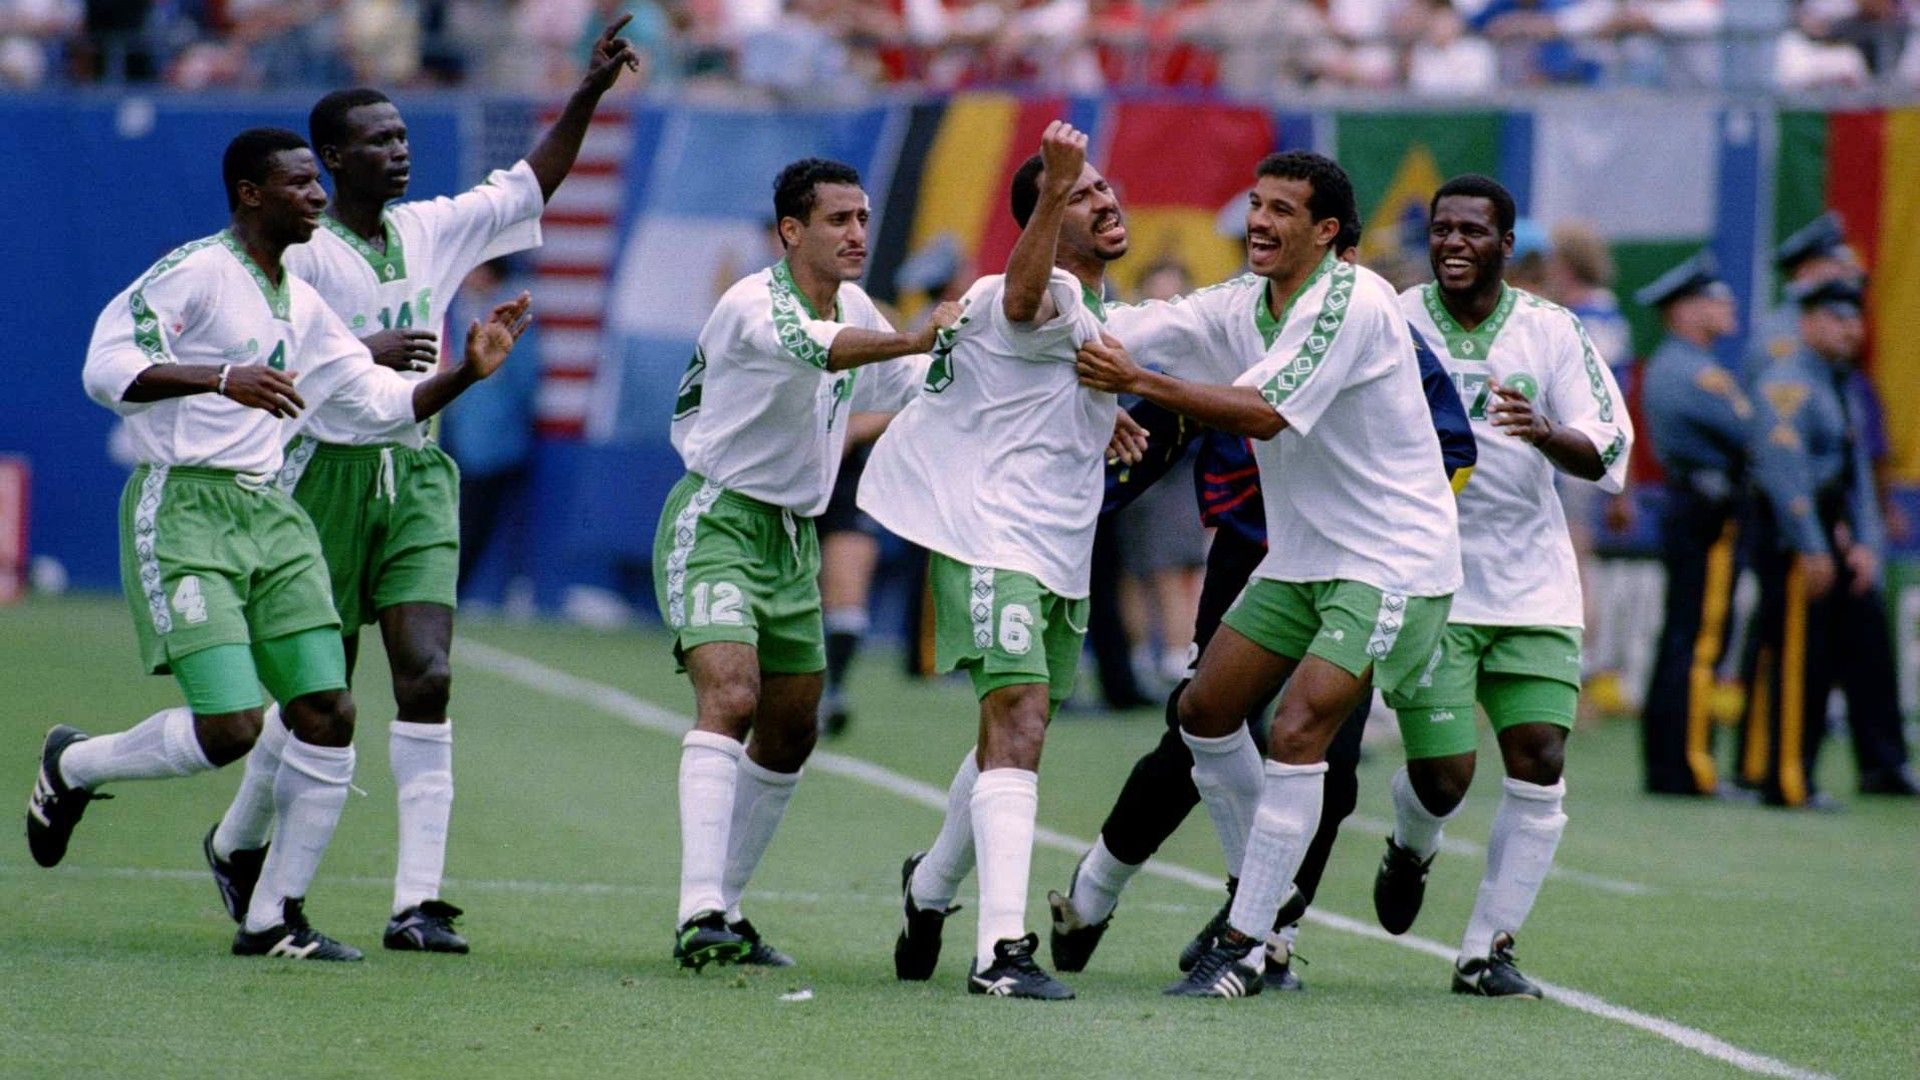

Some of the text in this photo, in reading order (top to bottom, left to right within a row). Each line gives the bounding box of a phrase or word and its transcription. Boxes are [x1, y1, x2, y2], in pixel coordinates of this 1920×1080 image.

[377, 302, 412, 330] 14
[267, 339, 286, 372] 4
[172, 575, 208, 623] 4
[691, 581, 743, 626] 12
[999, 604, 1033, 655] 6
